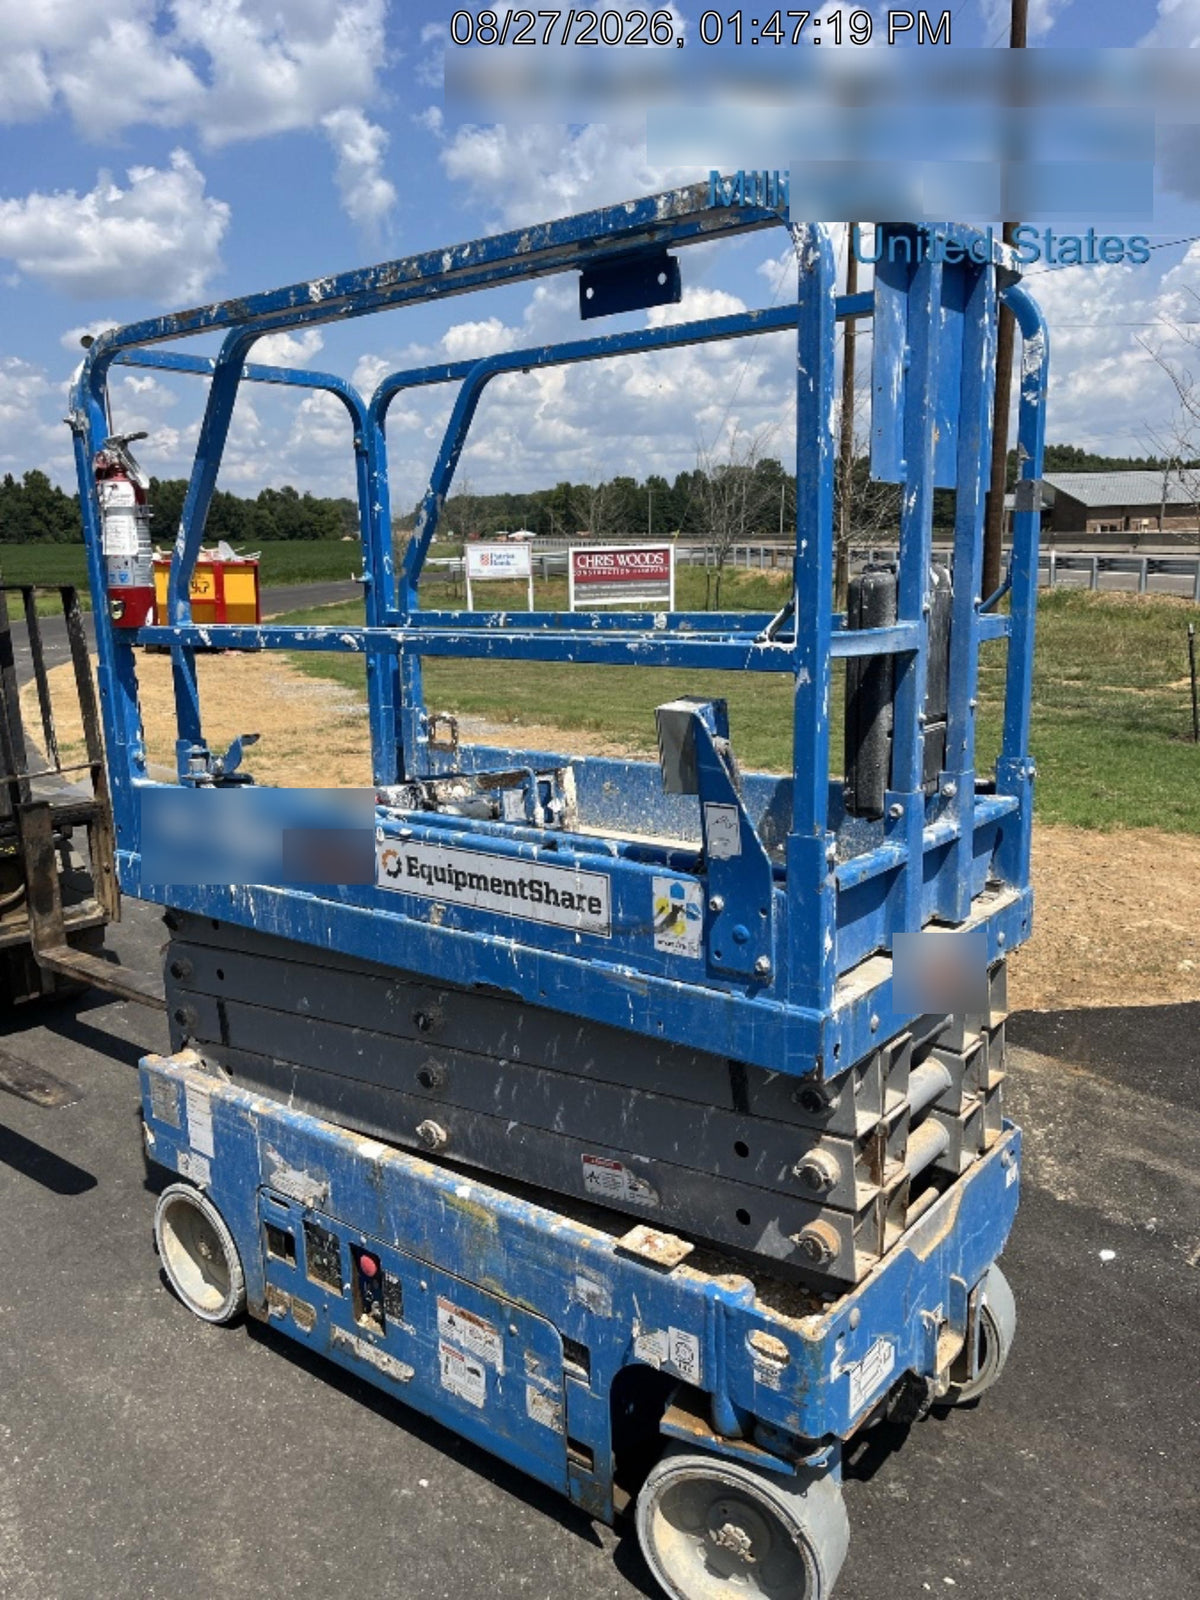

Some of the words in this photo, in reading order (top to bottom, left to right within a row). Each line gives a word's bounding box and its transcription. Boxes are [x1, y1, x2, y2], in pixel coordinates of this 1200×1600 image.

[577, 554, 615, 568] CHRIS
[616, 552, 664, 567] WOODS
[404, 855, 603, 916] EquipmentShare
